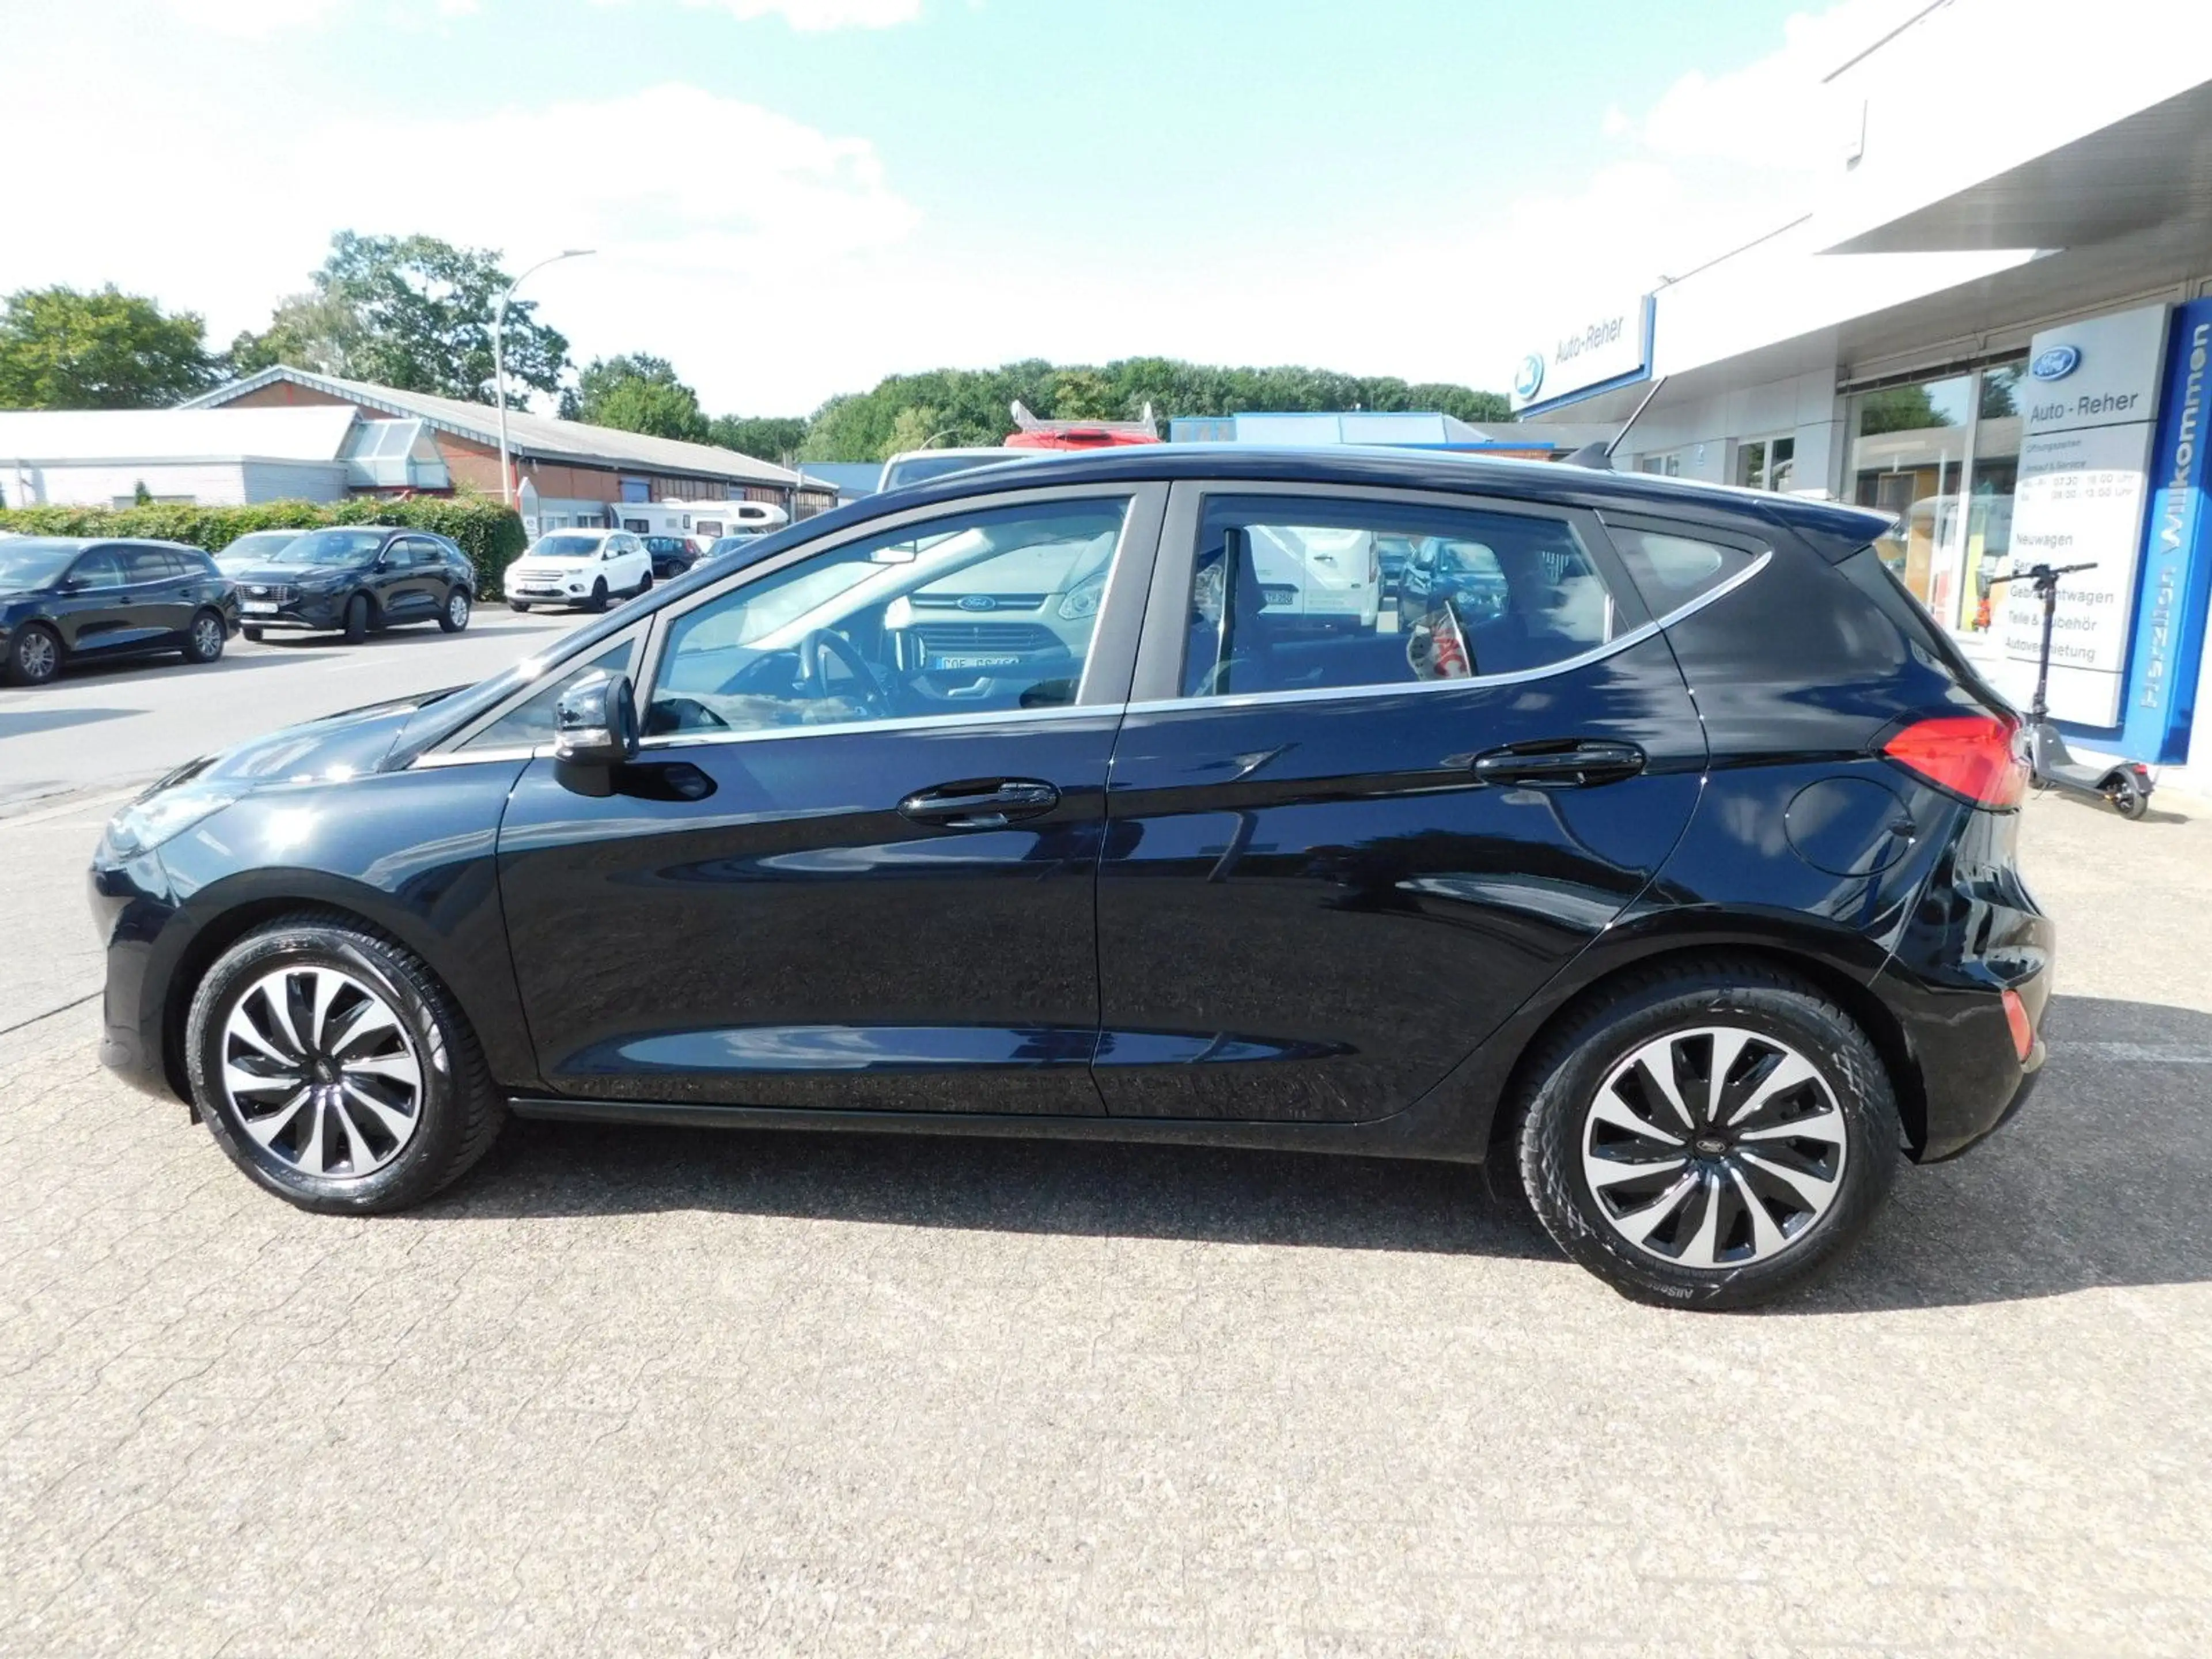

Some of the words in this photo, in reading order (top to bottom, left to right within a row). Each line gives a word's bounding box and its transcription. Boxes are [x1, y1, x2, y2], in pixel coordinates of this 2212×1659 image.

[2161, 324, 2210, 554] Willkommen
[2017, 533, 2074, 549] Neuwagen
[2042, 615, 2098, 631] ubehör
